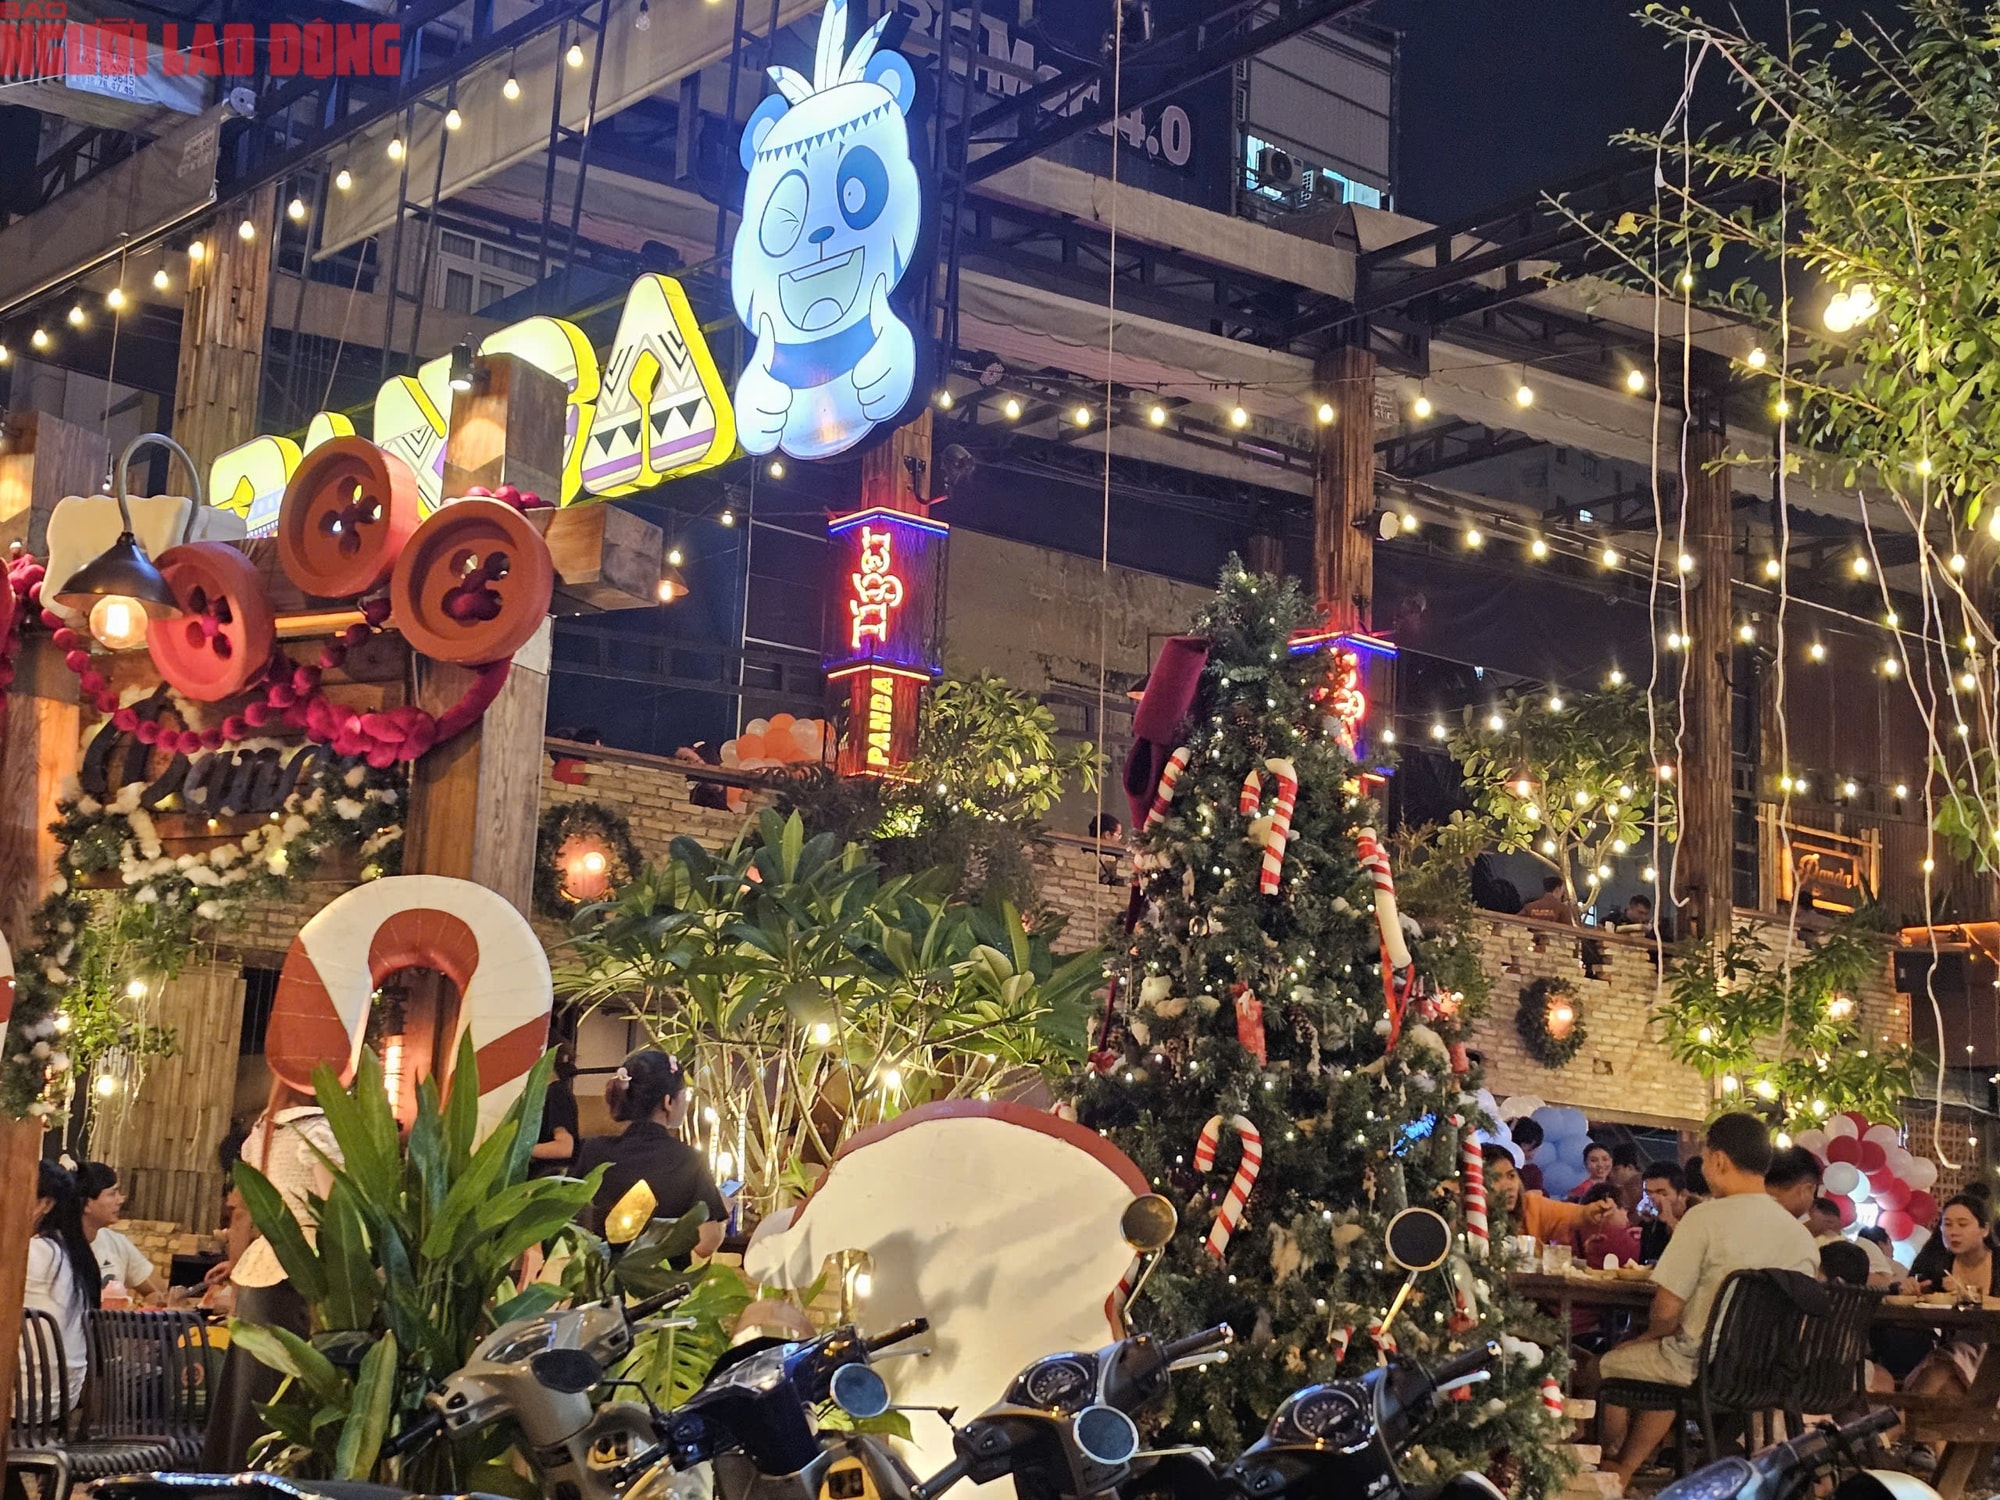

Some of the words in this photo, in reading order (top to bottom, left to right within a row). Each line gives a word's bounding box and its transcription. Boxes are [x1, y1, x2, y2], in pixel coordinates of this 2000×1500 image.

[849, 525, 904, 649] Tiger
[866, 677, 894, 767] PANDA
[1798, 853, 1853, 890] Panda
